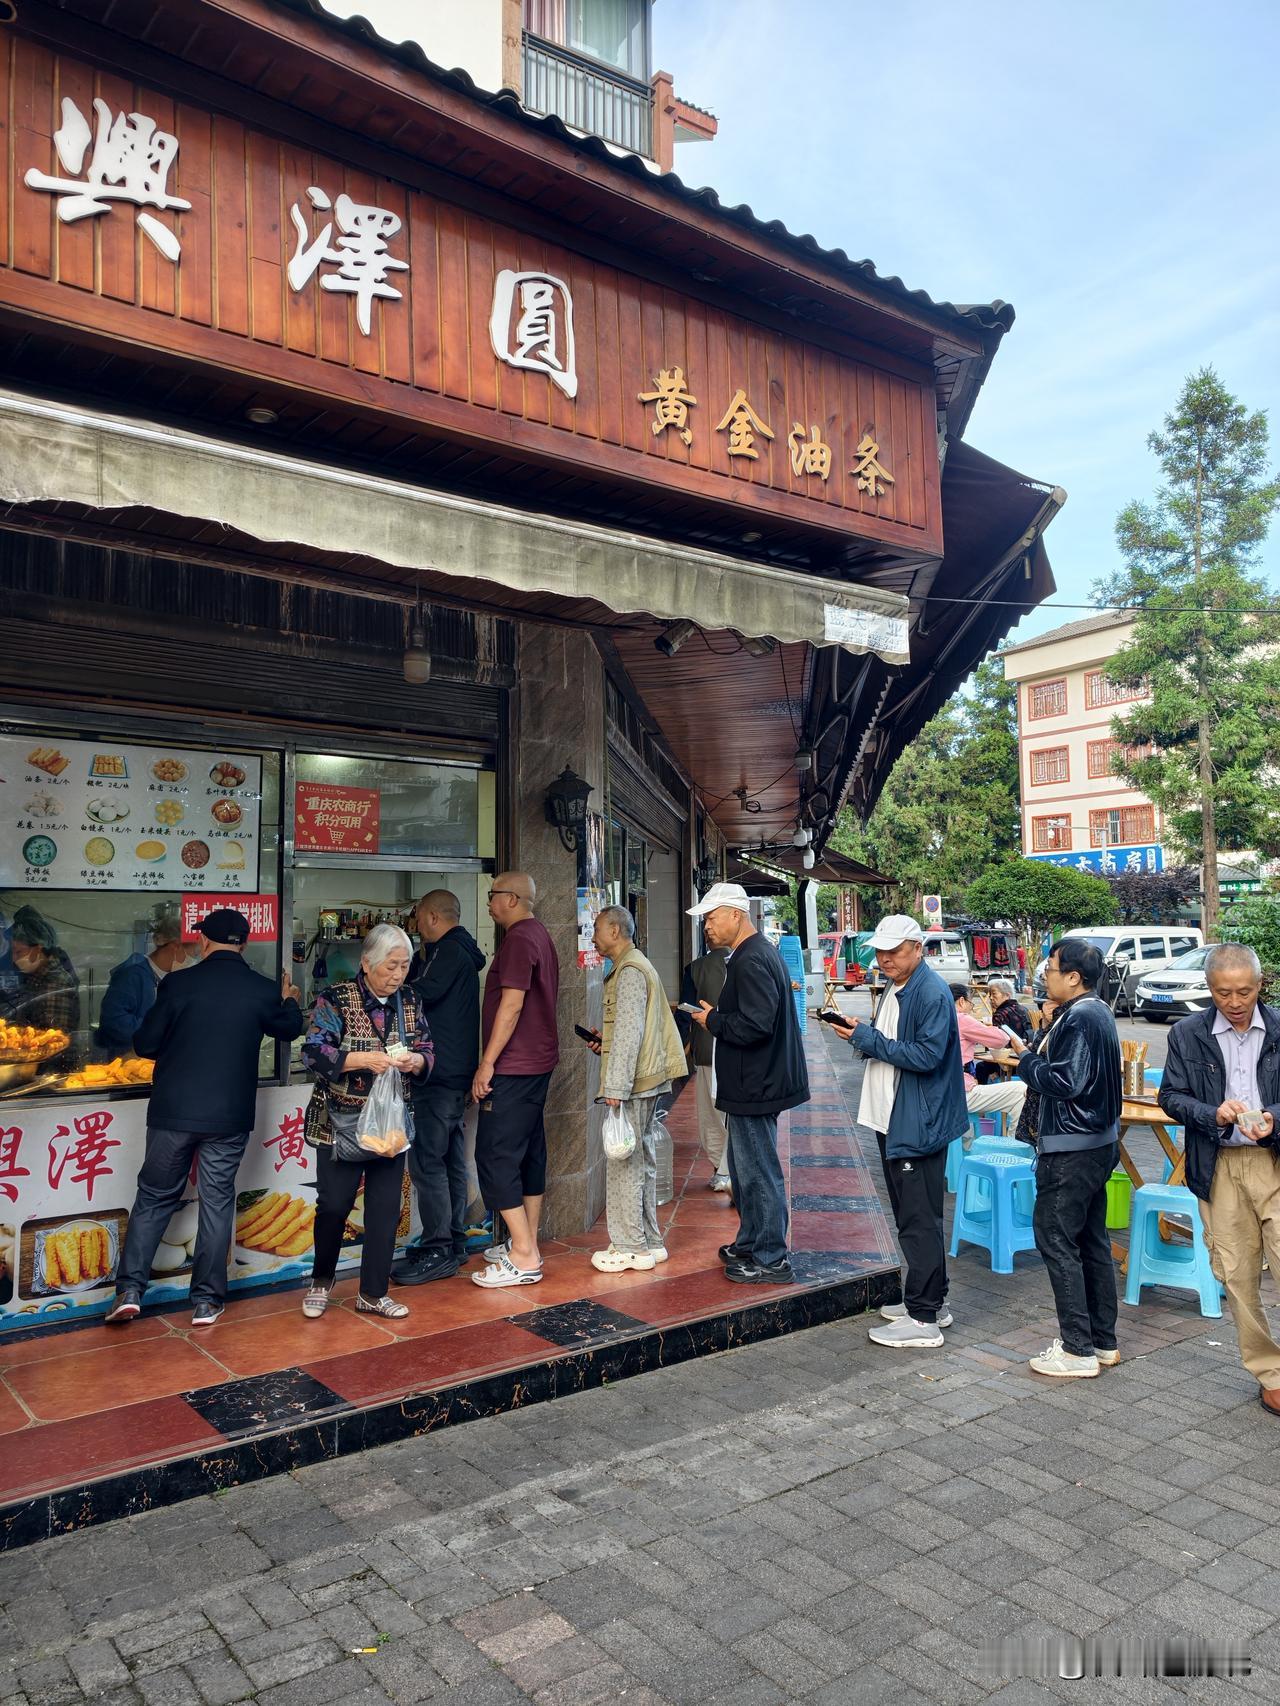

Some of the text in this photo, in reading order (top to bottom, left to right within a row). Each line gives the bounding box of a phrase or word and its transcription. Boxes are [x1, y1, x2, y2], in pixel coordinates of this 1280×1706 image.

[638, 366, 895, 496] 黄金油条
[304, 796, 372, 816] 重庆农商行
[80, 824, 105, 833] 白馒头
[314, 811, 362, 829] 积分可用
